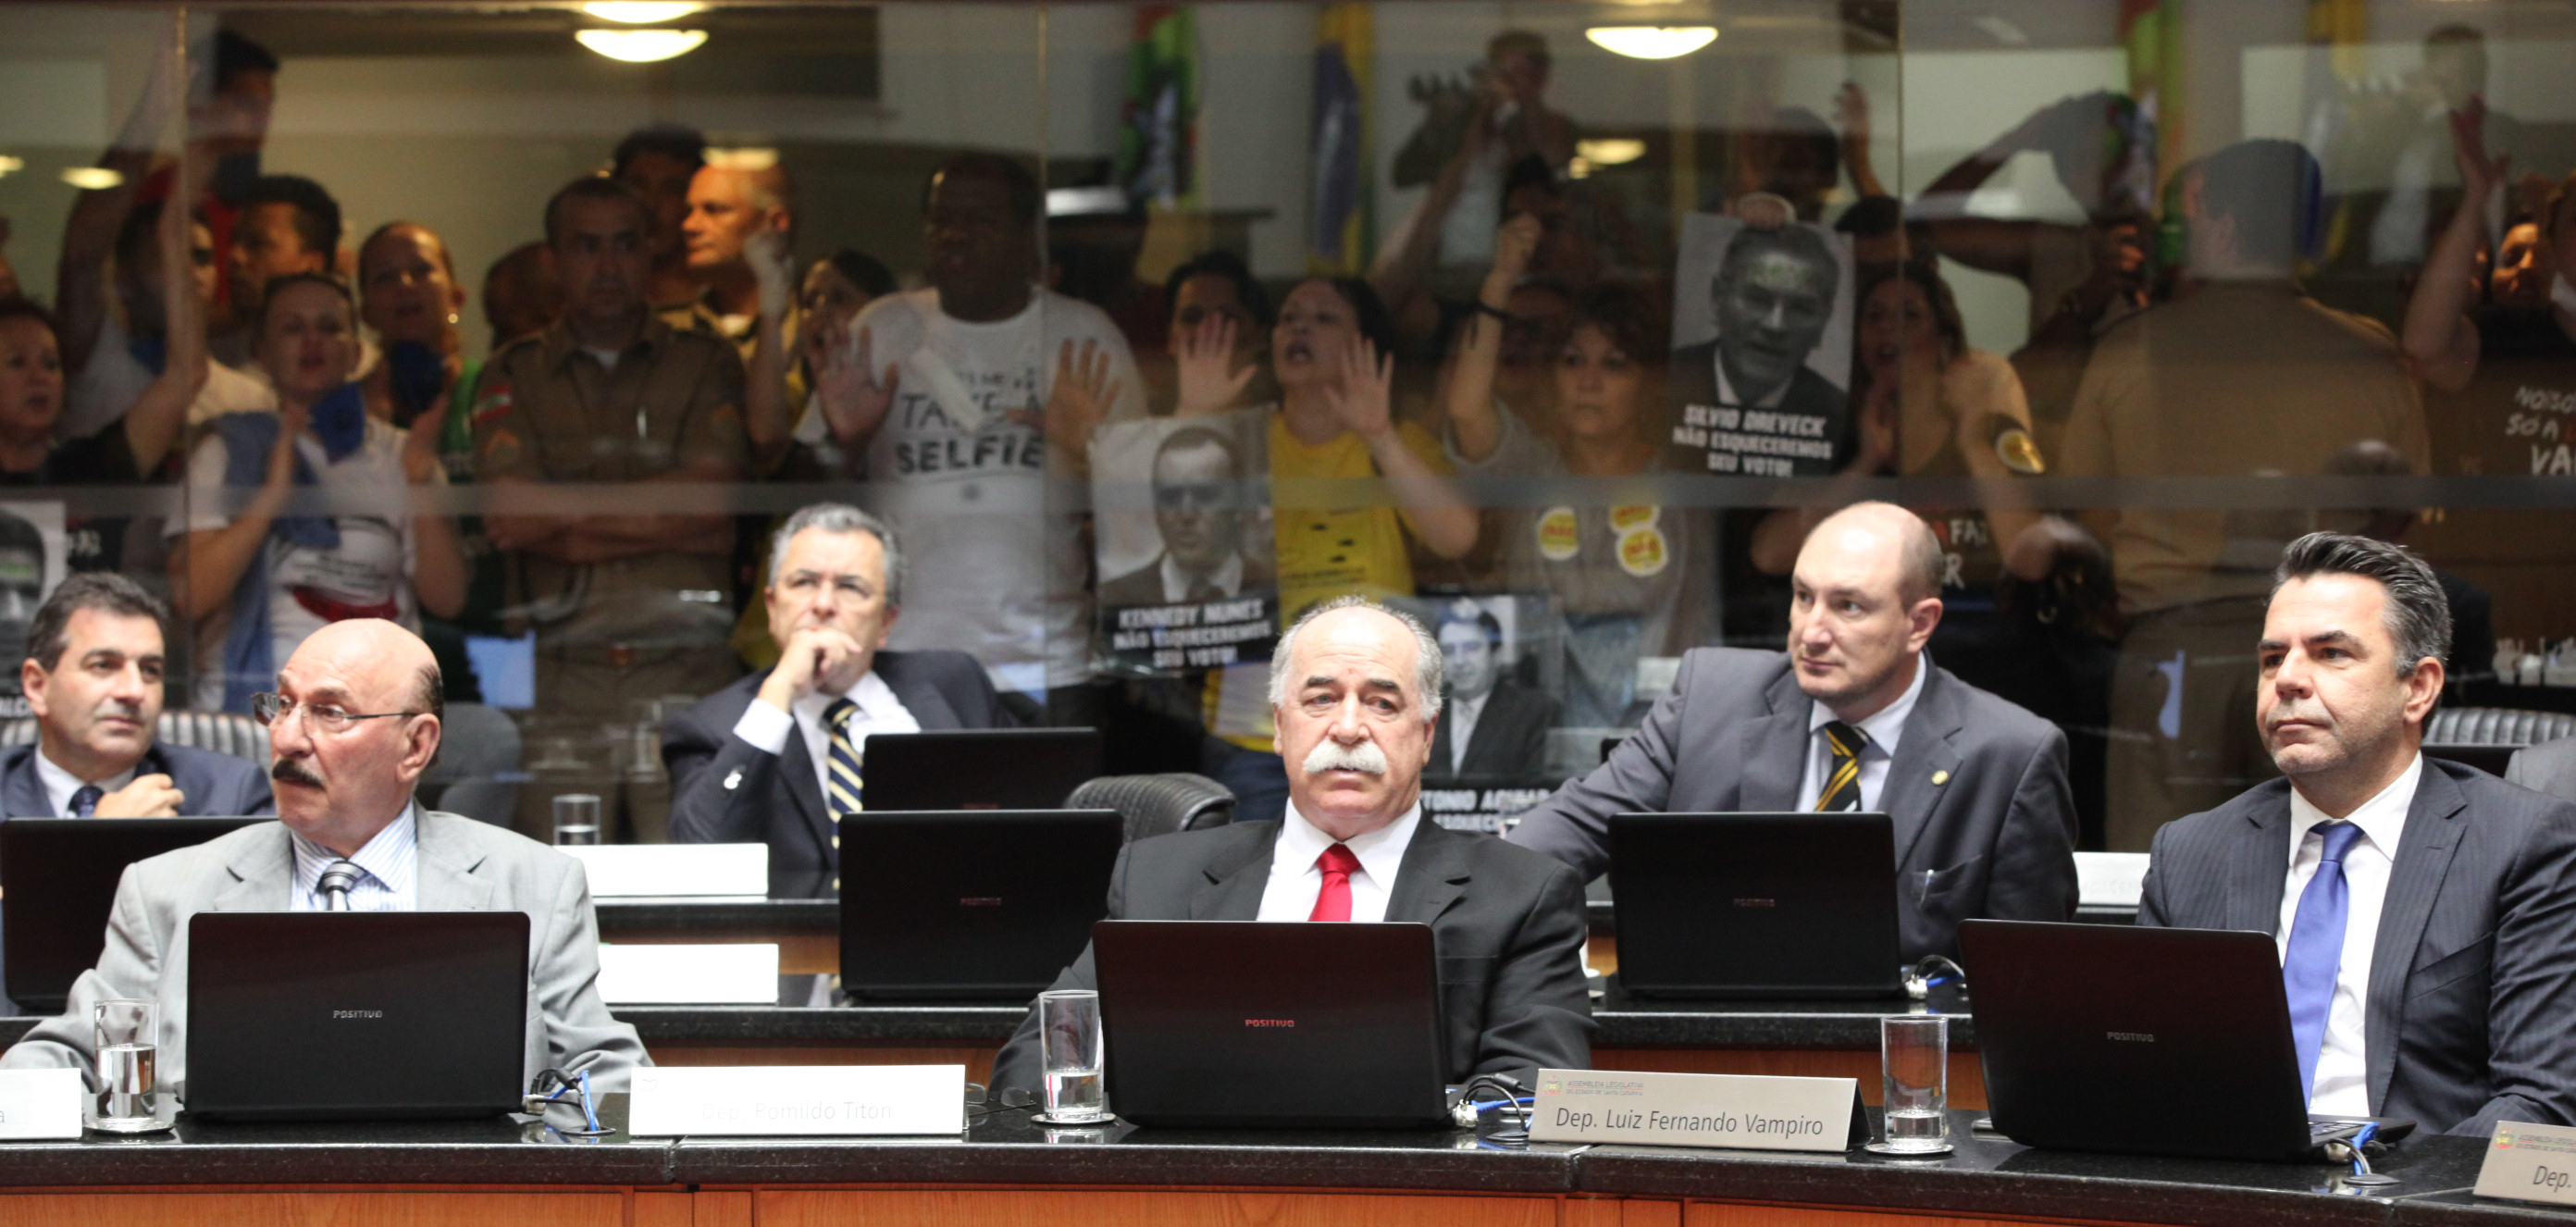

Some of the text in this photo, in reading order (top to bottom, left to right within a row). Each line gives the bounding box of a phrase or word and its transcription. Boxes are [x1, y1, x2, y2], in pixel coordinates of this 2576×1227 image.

[1672, 425, 1708, 448] NÃO
[896, 434, 1044, 475] SELFIE
[333, 1010, 383, 1019] POSITIVO
[1245, 1019, 1295, 1027] POSITIVO
[2106, 1032, 2155, 1043] POSITIVO
[702, 1101, 892, 1124] Dep. Romildo Titon
[1555, 1108, 1824, 1139] Dep. Luiz Fernando Vampiro
[2533, 1165, 2571, 1193] Dep.
